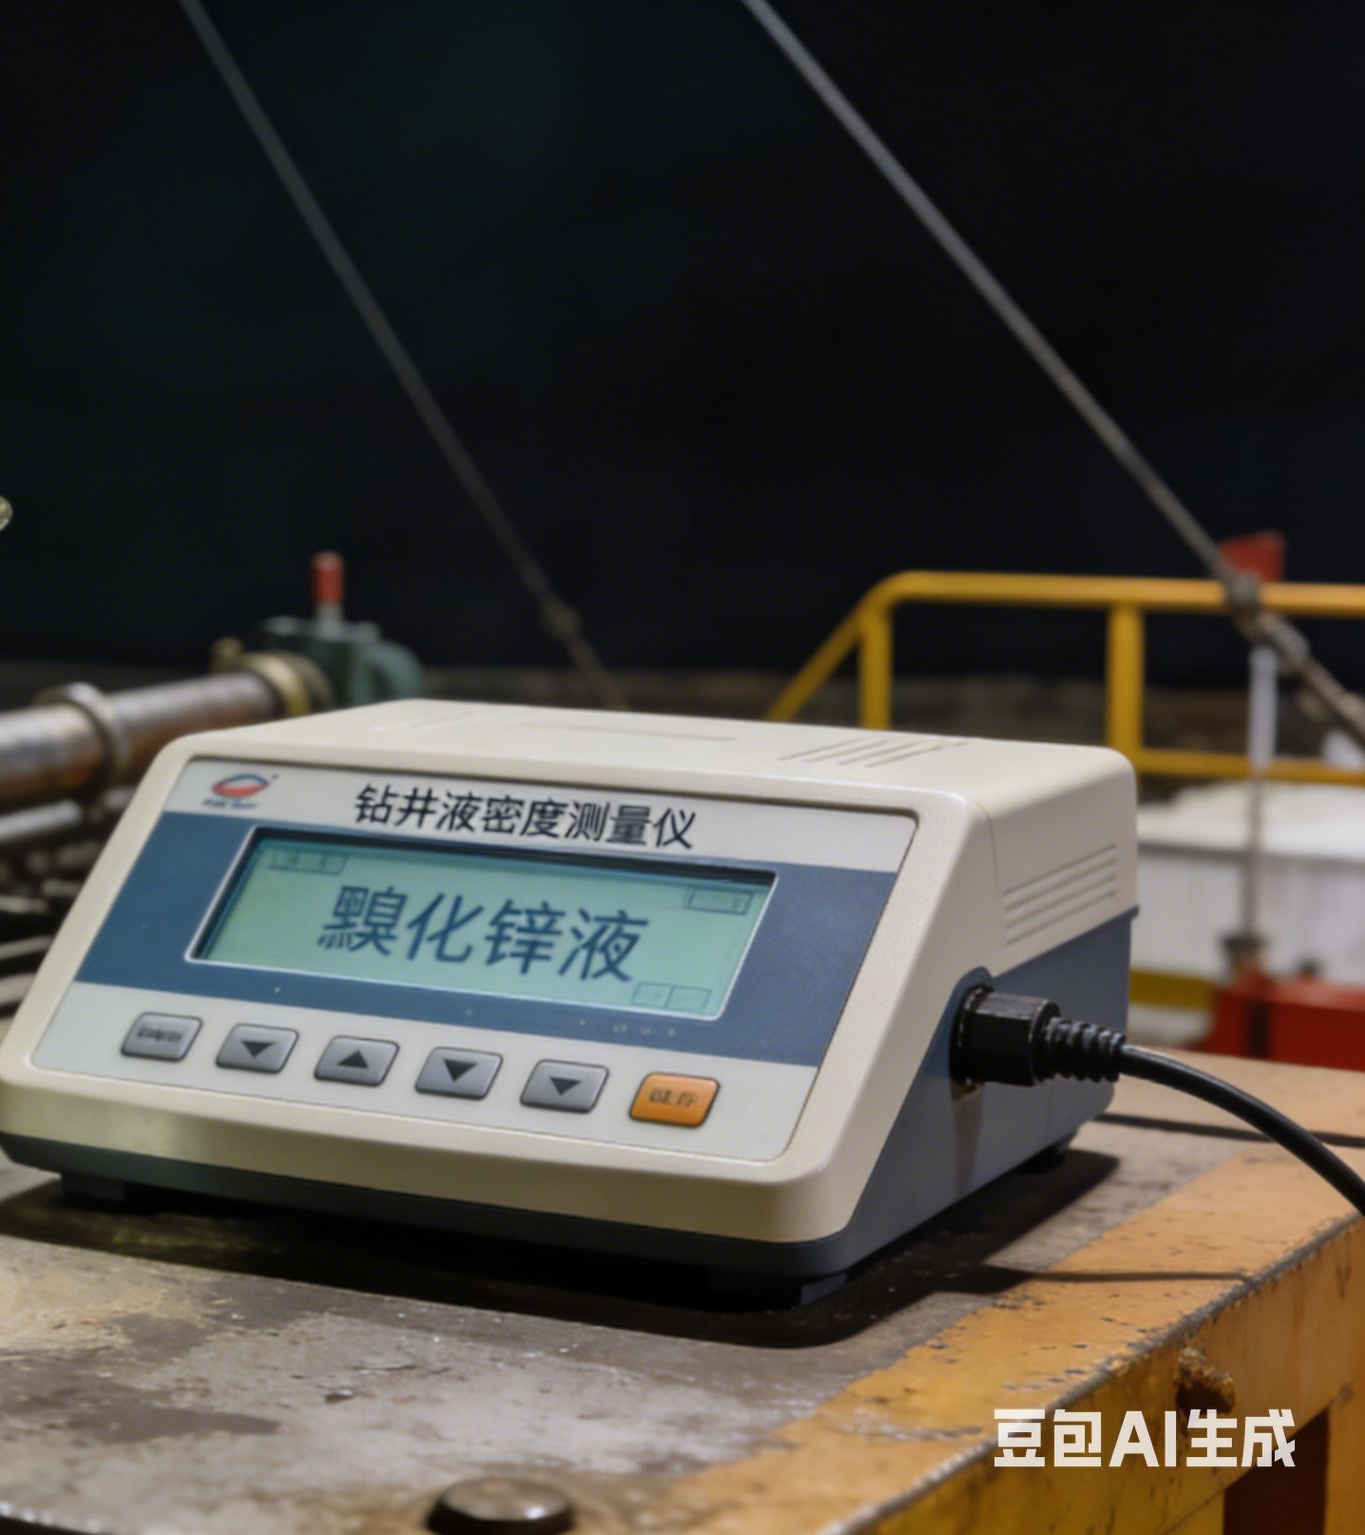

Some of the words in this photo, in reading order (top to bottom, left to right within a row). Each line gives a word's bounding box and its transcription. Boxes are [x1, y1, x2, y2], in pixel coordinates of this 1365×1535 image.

[353, 783, 697, 849] 钻井液密度测量仪
